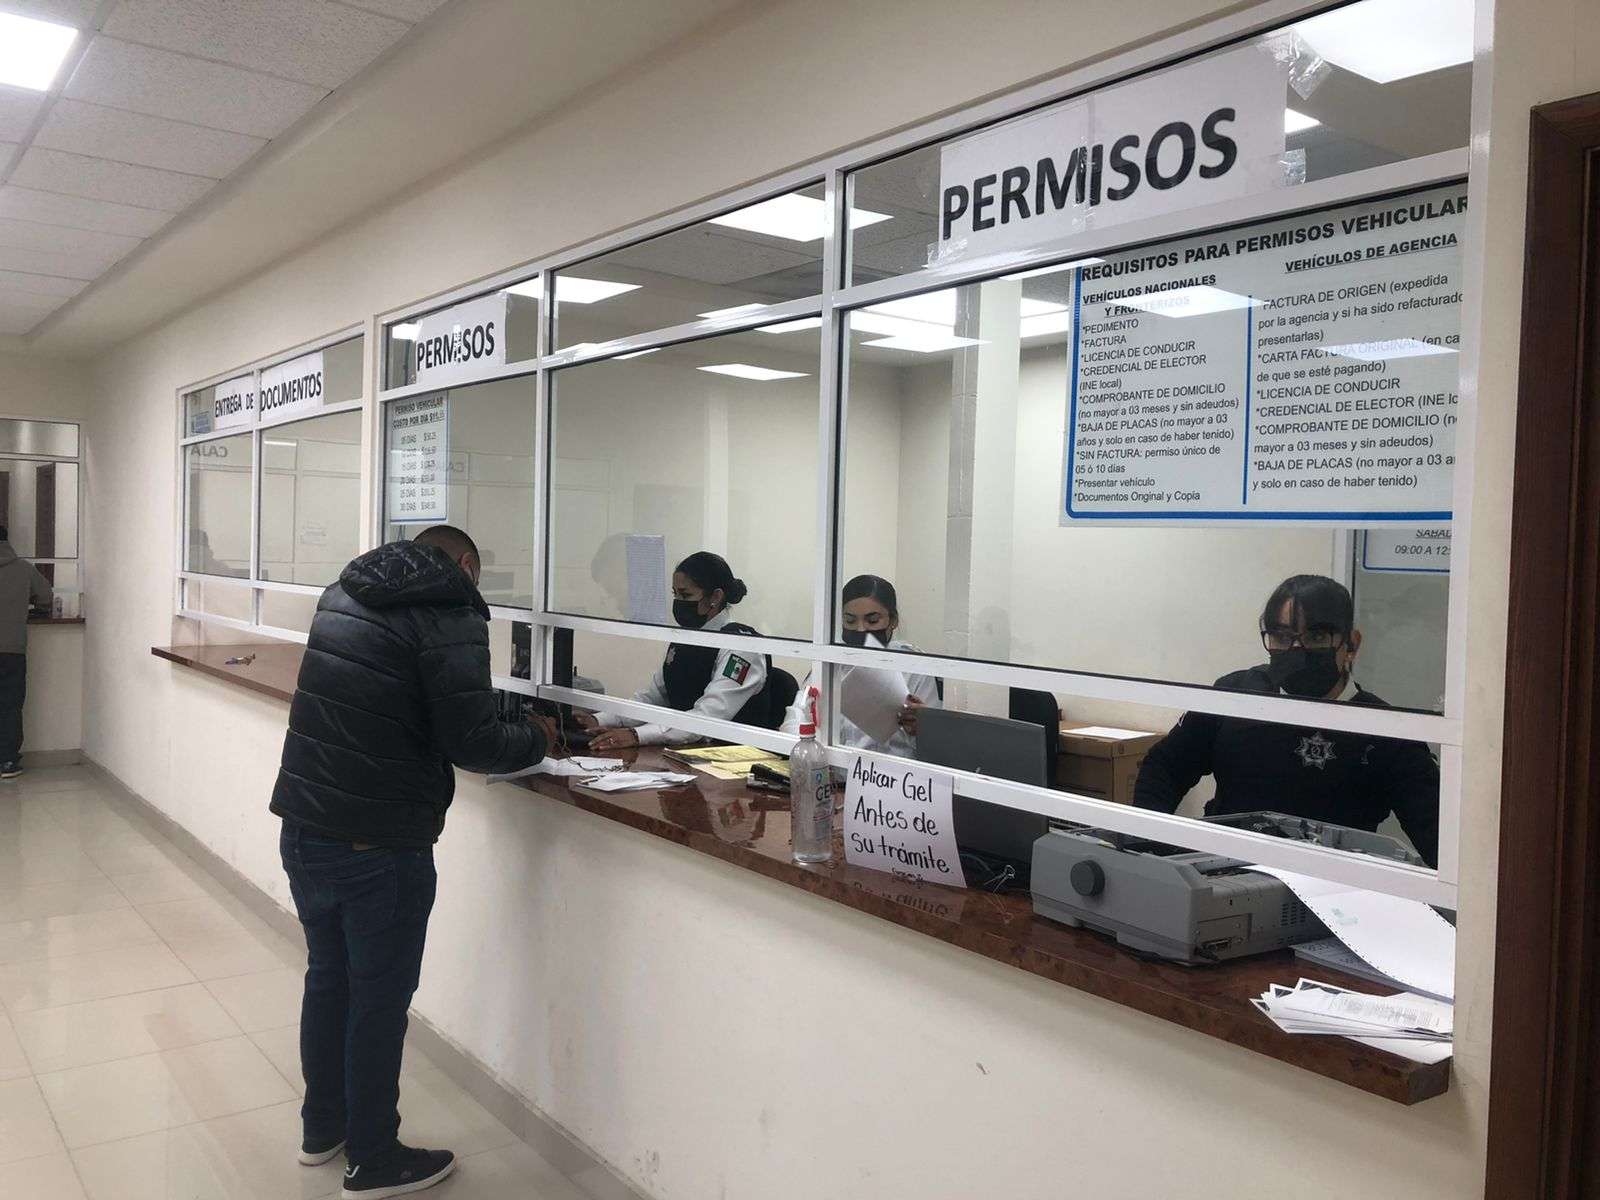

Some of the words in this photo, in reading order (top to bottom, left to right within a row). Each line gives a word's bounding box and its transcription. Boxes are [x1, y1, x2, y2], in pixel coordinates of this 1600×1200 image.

[943, 107, 1238, 241] PERMISOS
[1082, 253, 1178, 281] REQUISITOS
[1186, 244, 1230, 263] PARA
[1236, 221, 1334, 255] PERMISOS
[1285, 250, 1362, 273] VEHÍCULOS
[1366, 246, 1384, 259] DE
[1389, 233, 1457, 255] AGENCIA
[1083, 285, 1142, 304] VEHÍCULOS
[1145, 274, 1216, 294] NACIONALES
[1318, 291, 1334, 302] DE
[1338, 283, 1386, 300] ORIGEN
[1390, 274, 1448, 297] (expedida
[1105, 307, 1111, 316] Y
[1258, 317, 1274, 330] por
[1278, 315, 1286, 326] la
[1289, 311, 1329, 326] agencia
[1332, 311, 1339, 322] y
[1342, 305, 1350, 316] si
[1354, 306, 1367, 317] ha
[1371, 302, 1394, 313] sido
[417, 322, 495, 371] PERMISOS
[1128, 347, 1141, 357] DE
[1143, 340, 1195, 355] CONDUCIR
[1144, 360, 1157, 370] DE
[1160, 354, 1206, 369] ELECTOR
[1257, 372, 1269, 382] de
[1272, 371, 1290, 385] que
[1294, 370, 1305, 378] se
[1334, 360, 1386, 377] pagando)
[1080, 381, 1097, 391] (INE
[1099, 379, 1122, 390] local)
[1157, 387, 1170, 398] DE
[1173, 383, 1225, 397] DOMICILIO
[1315, 384, 1331, 395] DE
[1335, 378, 1401, 393] CONDUCIR
[215, 394, 242, 418] ENTREGA
[246, 393, 254, 409] DE
[260, 372, 322, 412] DOCUMENTOS
[1335, 401, 1352, 412] DE
[1356, 396, 1414, 411] ELECTOR
[1418, 394, 1444, 409] (INE
[1078, 410, 1091, 420] (no
[1093, 407, 1118, 419] mayor
[1129, 404, 1139, 415] 03
[1142, 404, 1170, 414] meses
[1173, 403, 1178, 413] y
[1181, 400, 1193, 411] sin
[1196, 397, 1239, 410] adeudos)
[1105, 421, 1118, 431] DE
[1120, 418, 1157, 429] PLACAS
[1160, 416, 1174, 428] (no
[1177, 416, 1204, 428] mayor
[1208, 416, 1213, 424] a
[1216, 413, 1227, 423] 03
[1352, 419, 1368, 430] DE
[1372, 415, 1439, 428] DOMICILIO
[1077, 435, 1096, 447] años
[1099, 437, 1103, 447] y
[1106, 434, 1122, 445] solo
[1125, 435, 1135, 444] en
[1138, 433, 1158, 443] caso
[1160, 431, 1171, 442] de
[1174, 428, 1199, 441] haber
[1202, 429, 1234, 440] tenido)
[1254, 444, 1285, 459] mayor
[1288, 443, 1294, 451] a
[1297, 442, 1309, 451] 03
[1313, 440, 1347, 451] meses
[1351, 440, 1357, 451] y
[1360, 437, 1376, 448] sin
[1379, 434, 1433, 448] adeudos)
[1145, 445, 1180, 458] permiso
[1183, 444, 1206, 455] único
[1209, 444, 1220, 454] de
[1075, 466, 1085, 474] 05
[1096, 465, 1105, 473] 10
[1288, 459, 1304, 469] DE
[1307, 457, 1353, 469] PLACAS
[1357, 456, 1374, 469] (no
[1377, 455, 1411, 469] mayor
[1416, 456, 1423, 466] a
[1427, 454, 1441, 465] 03
[1446, 456, 1455, 465] a
[1252, 480, 1259, 492] y
[1261, 477, 1281, 489] solo
[1285, 478, 1297, 488] en
[1300, 477, 1324, 488] caso
[1327, 475, 1340, 487] de
[1344, 474, 1374, 487] haber
[1378, 474, 1417, 488] tenido)
[1167, 493, 1172, 502] y
[1174, 490, 1200, 501] Copia
[1395, 545, 1423, 554] 09:00
[1425, 546, 1432, 555] A
[852, 756, 897, 788] Aplicar
[903, 772, 932, 802] Gel
[854, 796, 908, 830] Antes
[914, 811, 938, 836] de
